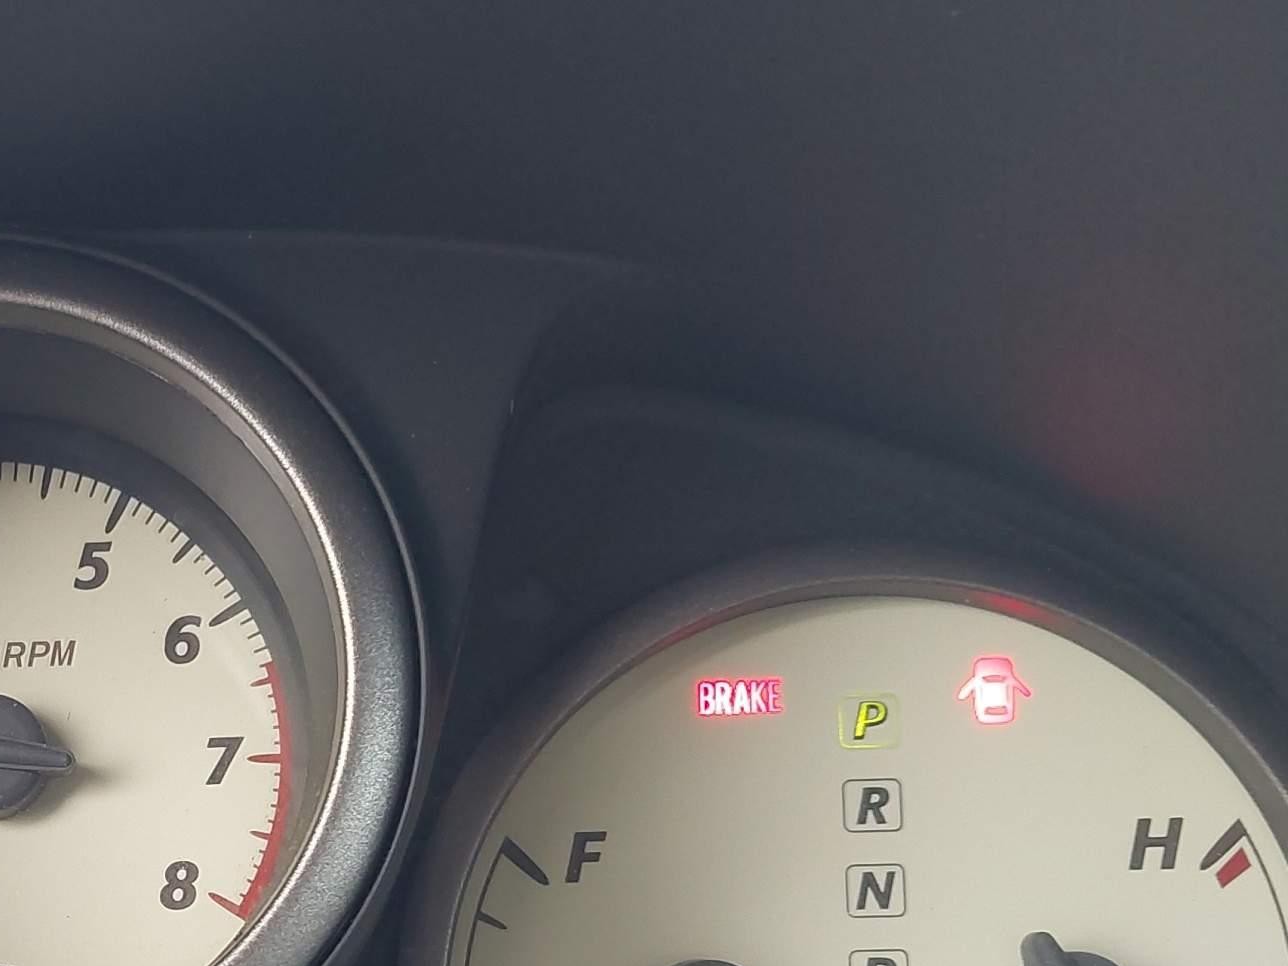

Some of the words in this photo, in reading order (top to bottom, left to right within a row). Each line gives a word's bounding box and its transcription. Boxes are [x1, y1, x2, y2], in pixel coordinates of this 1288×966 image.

[73, 541, 111, 589] 5
[3, 640, 76, 668] RPM
[164, 615, 202, 664] 6
[697, 680, 782, 716] BRAKE
[853, 700, 888, 741] P
[205, 736, 244, 786] 7
[856, 786, 890, 826] R
[565, 831, 607, 884] F
[1128, 817, 1184, 871] H
[159, 860, 198, 910] 8
[855, 870, 896, 910] N
